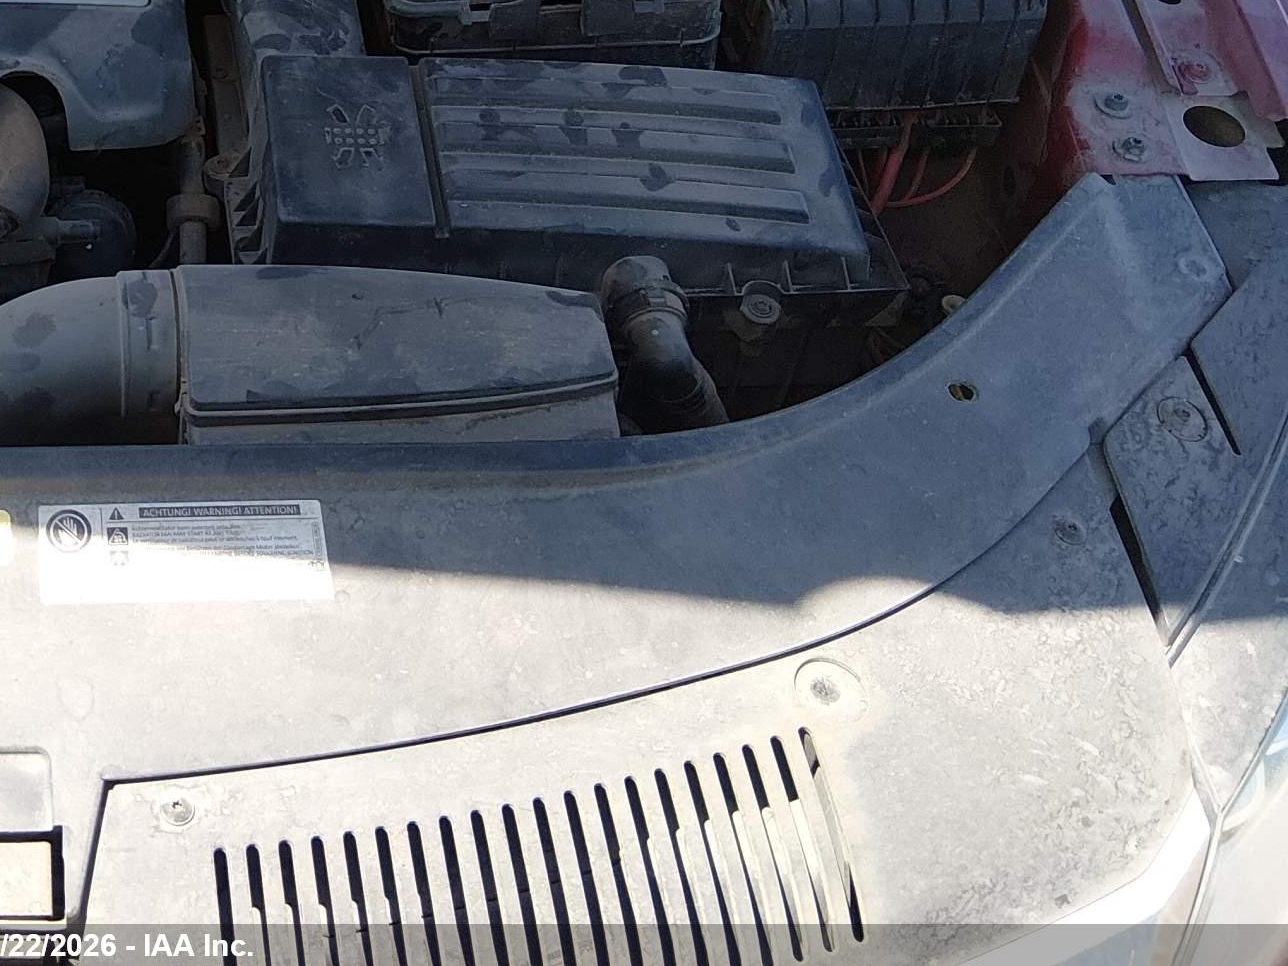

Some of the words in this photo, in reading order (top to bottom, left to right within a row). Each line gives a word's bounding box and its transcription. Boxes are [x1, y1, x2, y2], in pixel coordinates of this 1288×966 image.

[143, 508, 191, 517] ACHTUNG!
[193, 507, 241, 516] WARNING!
[243, 506, 297, 515] ATTENTION!
